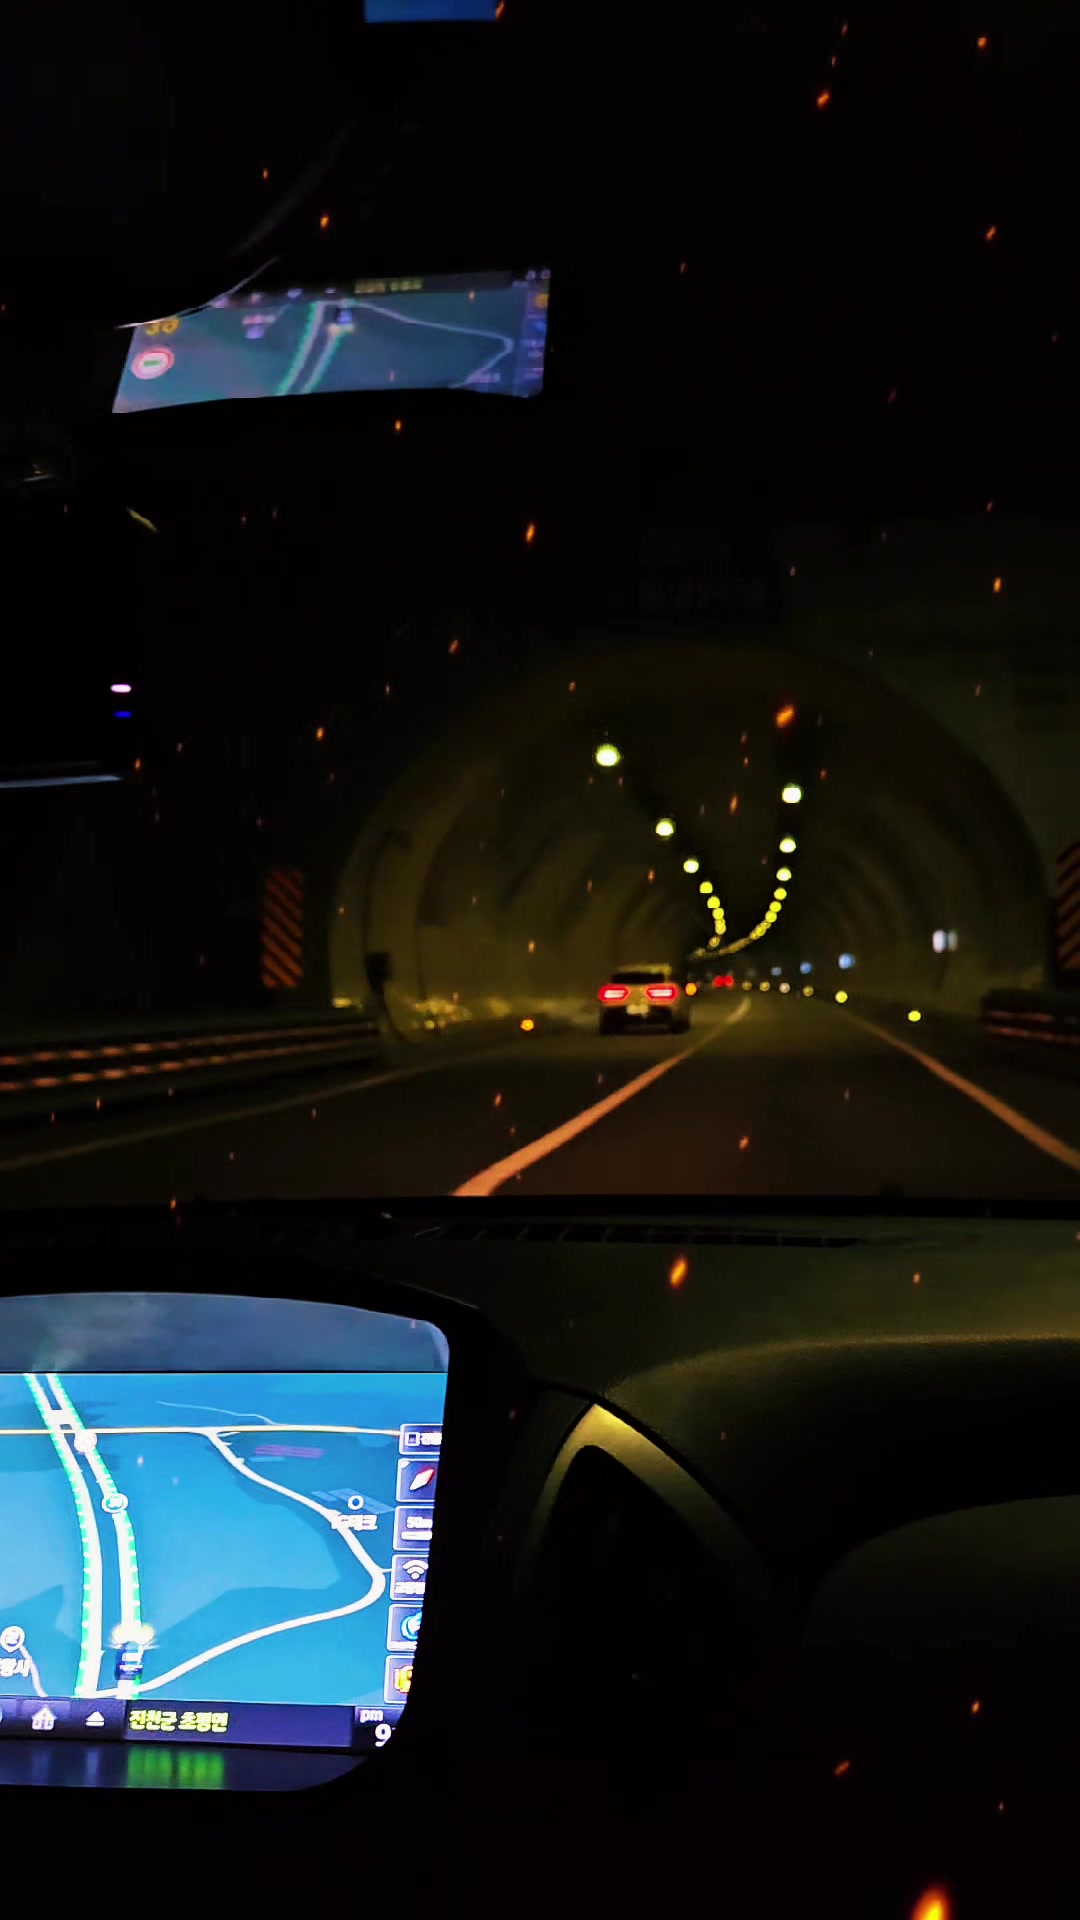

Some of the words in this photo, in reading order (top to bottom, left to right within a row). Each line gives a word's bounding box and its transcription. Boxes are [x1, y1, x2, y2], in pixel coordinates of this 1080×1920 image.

[129, 1710, 177, 1732] 진천군
[178, 1711, 229, 1733] 초평면
[359, 1709, 384, 1723] pm
